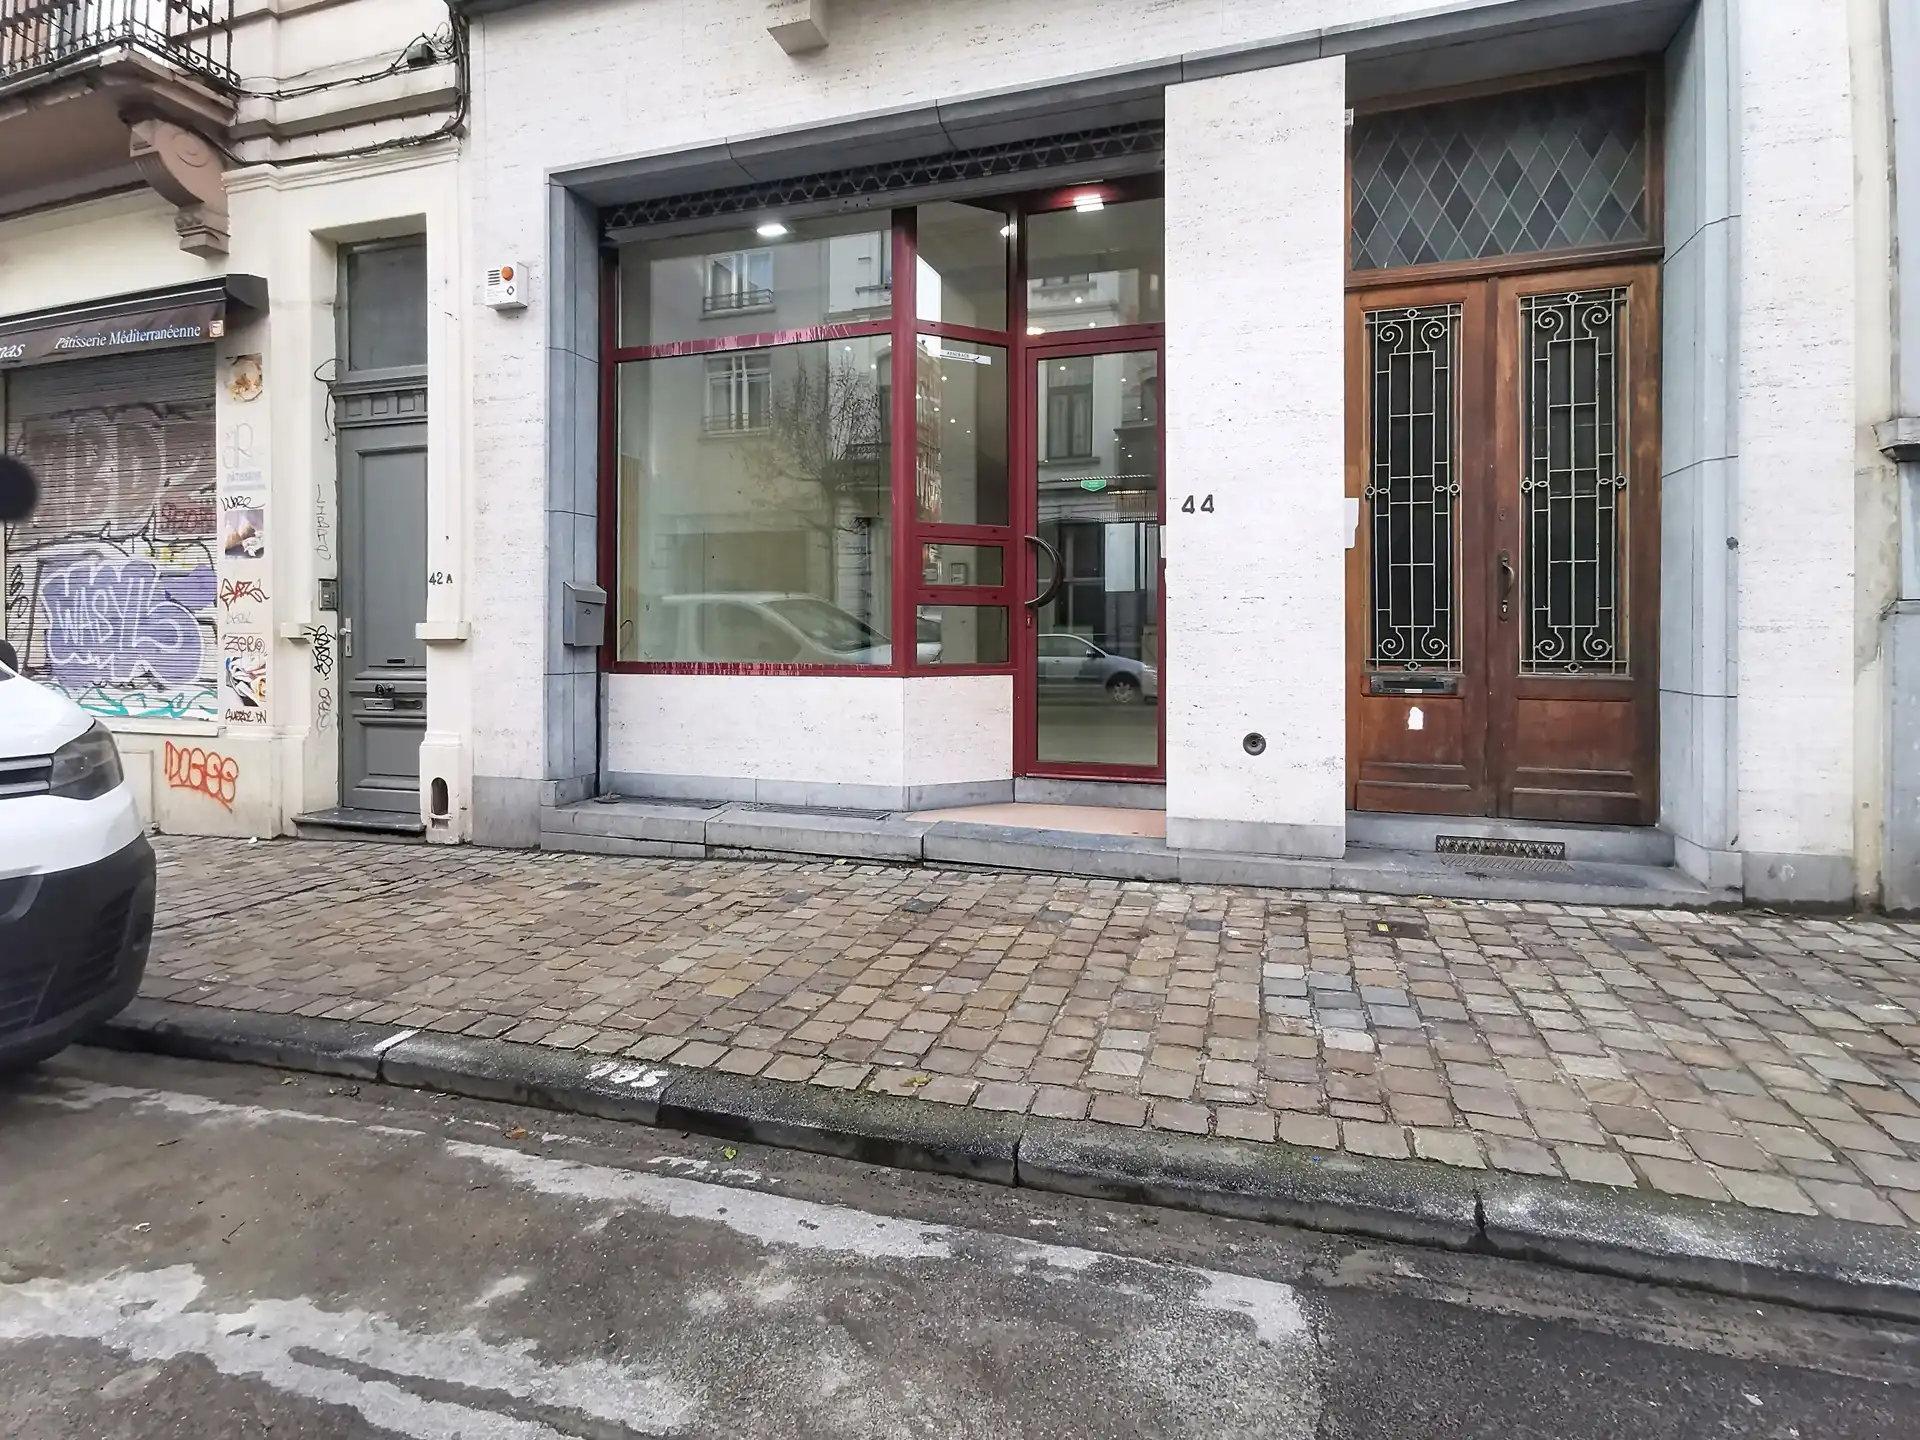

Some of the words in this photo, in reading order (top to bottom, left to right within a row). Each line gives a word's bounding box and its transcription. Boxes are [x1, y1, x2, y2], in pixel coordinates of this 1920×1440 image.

[54, 334, 107, 350] Pâtisserie
[109, 325, 201, 346] Méditerranéenne
[1181, 494, 1215, 514] 44
[428, 571, 444, 586] 42
